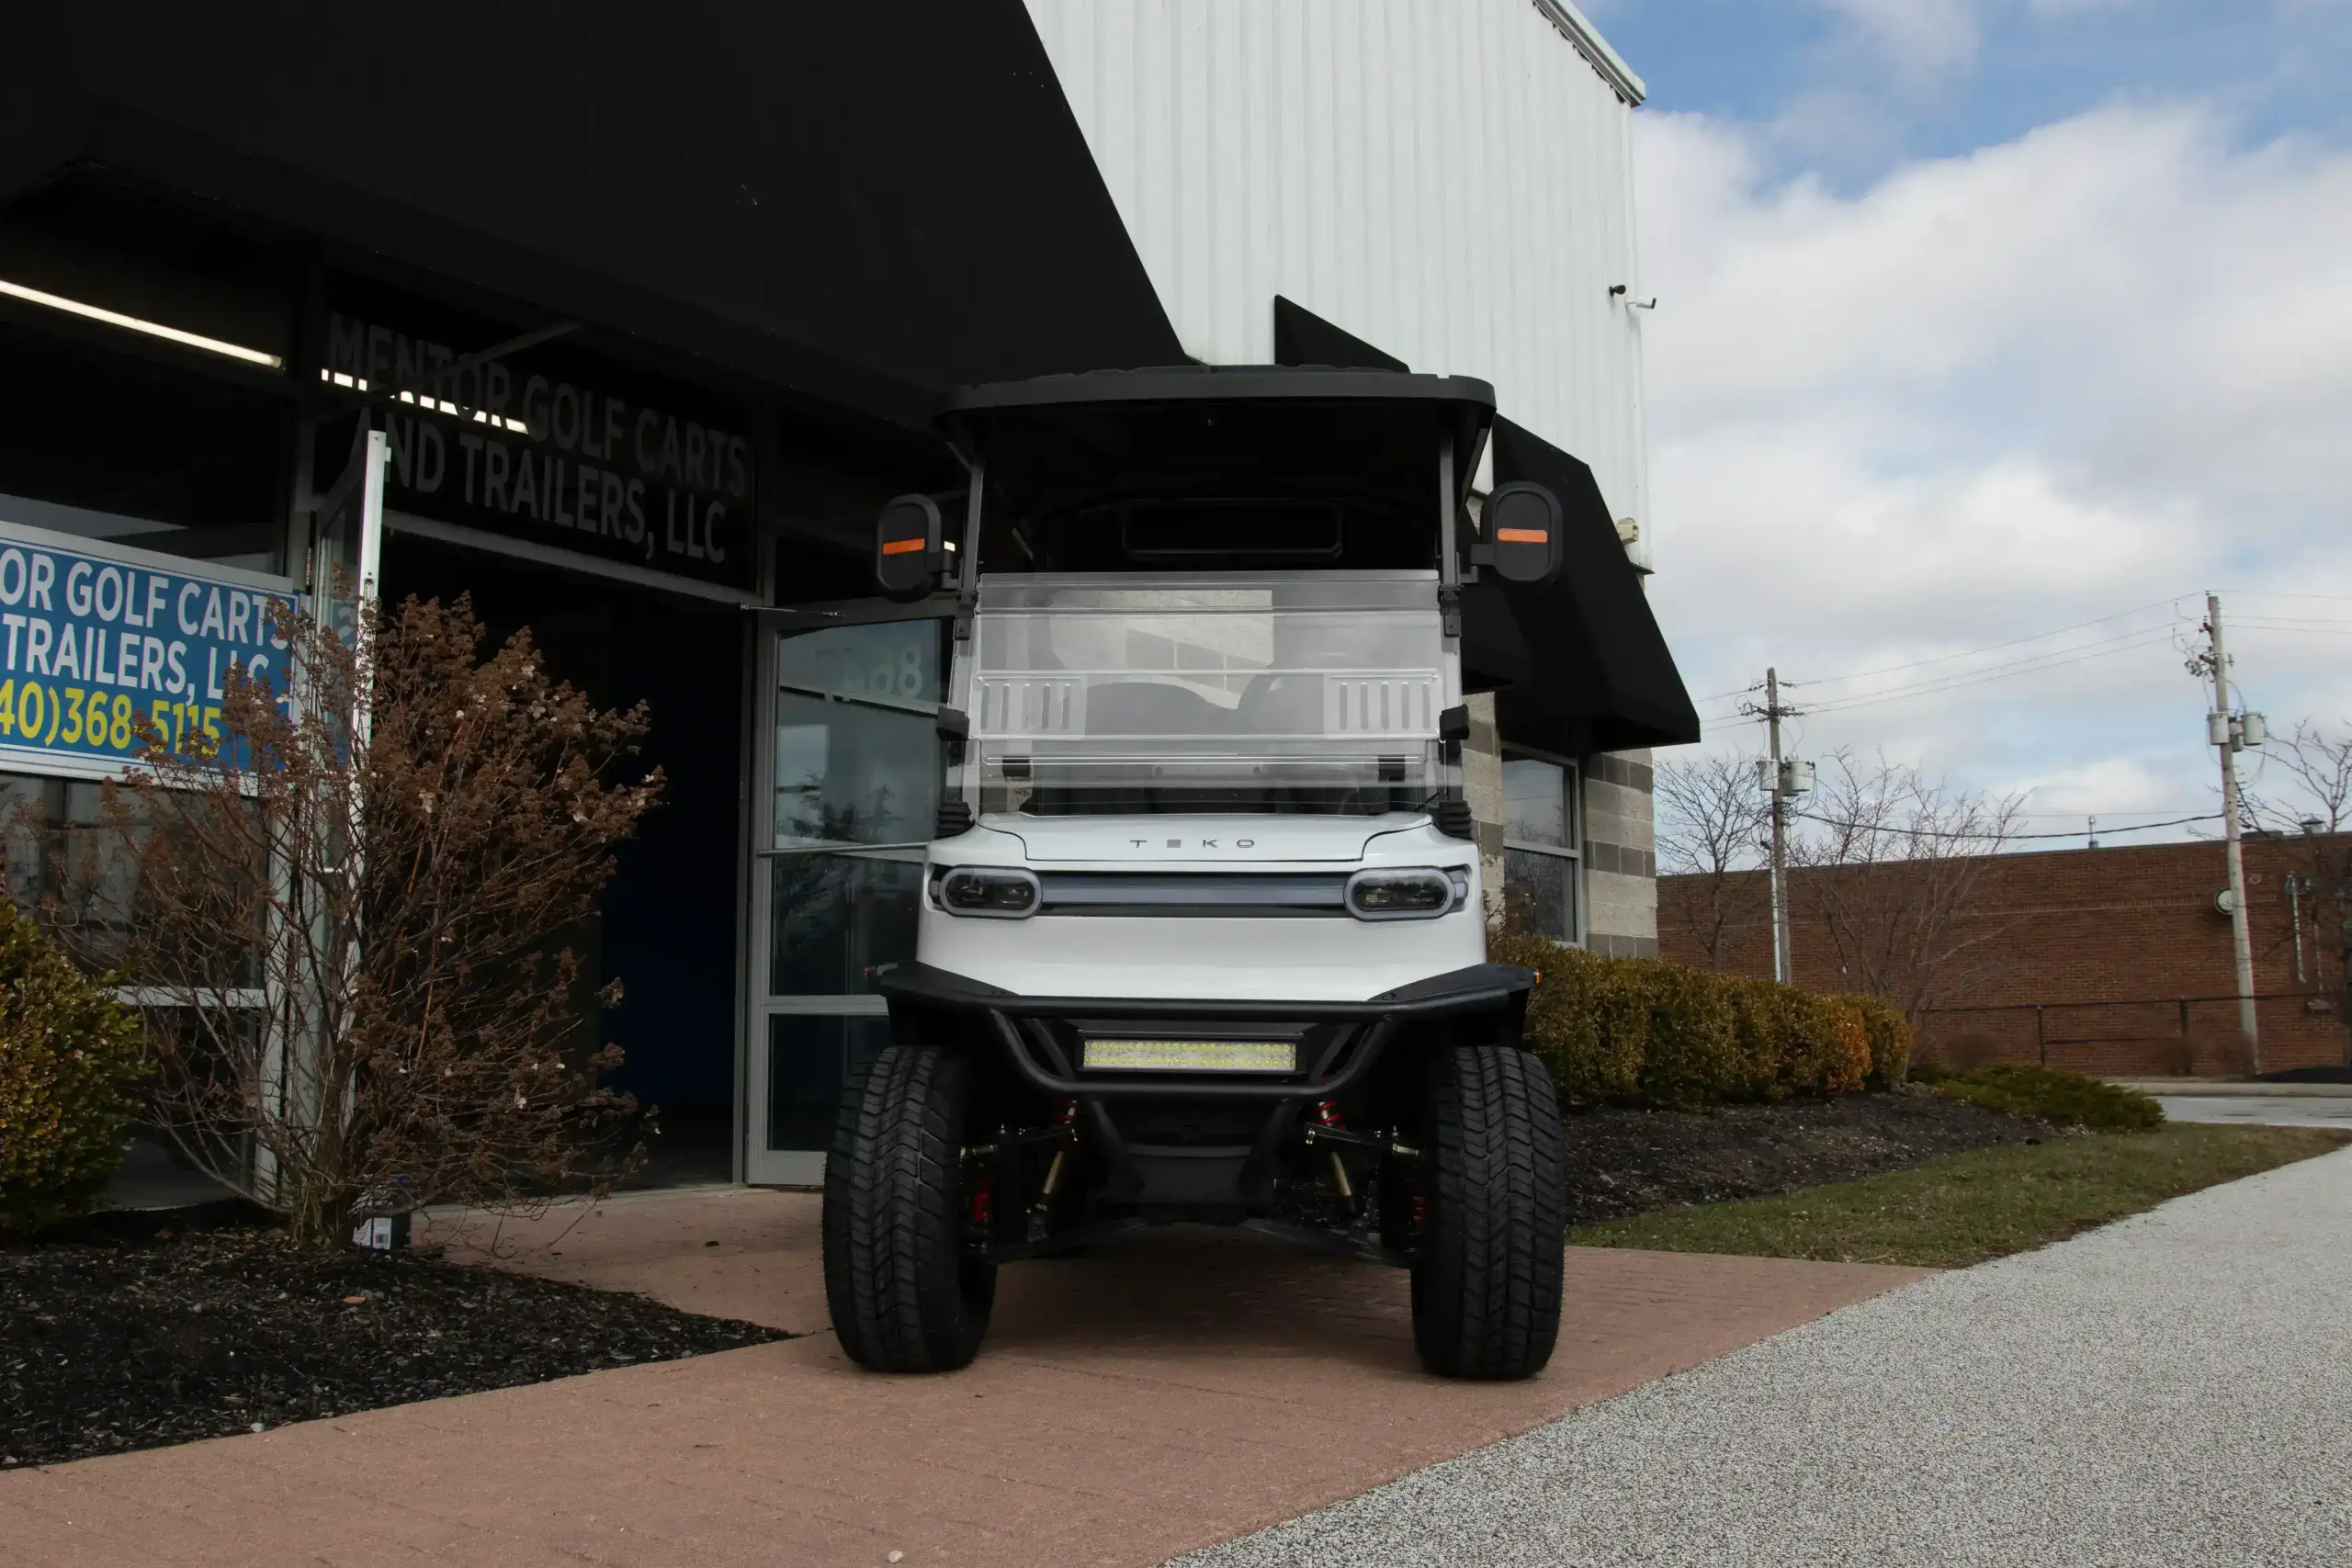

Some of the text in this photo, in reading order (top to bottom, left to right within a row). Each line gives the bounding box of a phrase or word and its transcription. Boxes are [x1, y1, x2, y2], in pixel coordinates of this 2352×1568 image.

[329, 312, 746, 497] MENTOR GOLF CARTS
[459, 432, 655, 560] TRAILERS,
[667, 488, 726, 563] LLC
[66, 561, 169, 628] GOLF
[2, 613, 197, 707] TRAILERS,
[1129, 839, 1255, 849] TEKO
